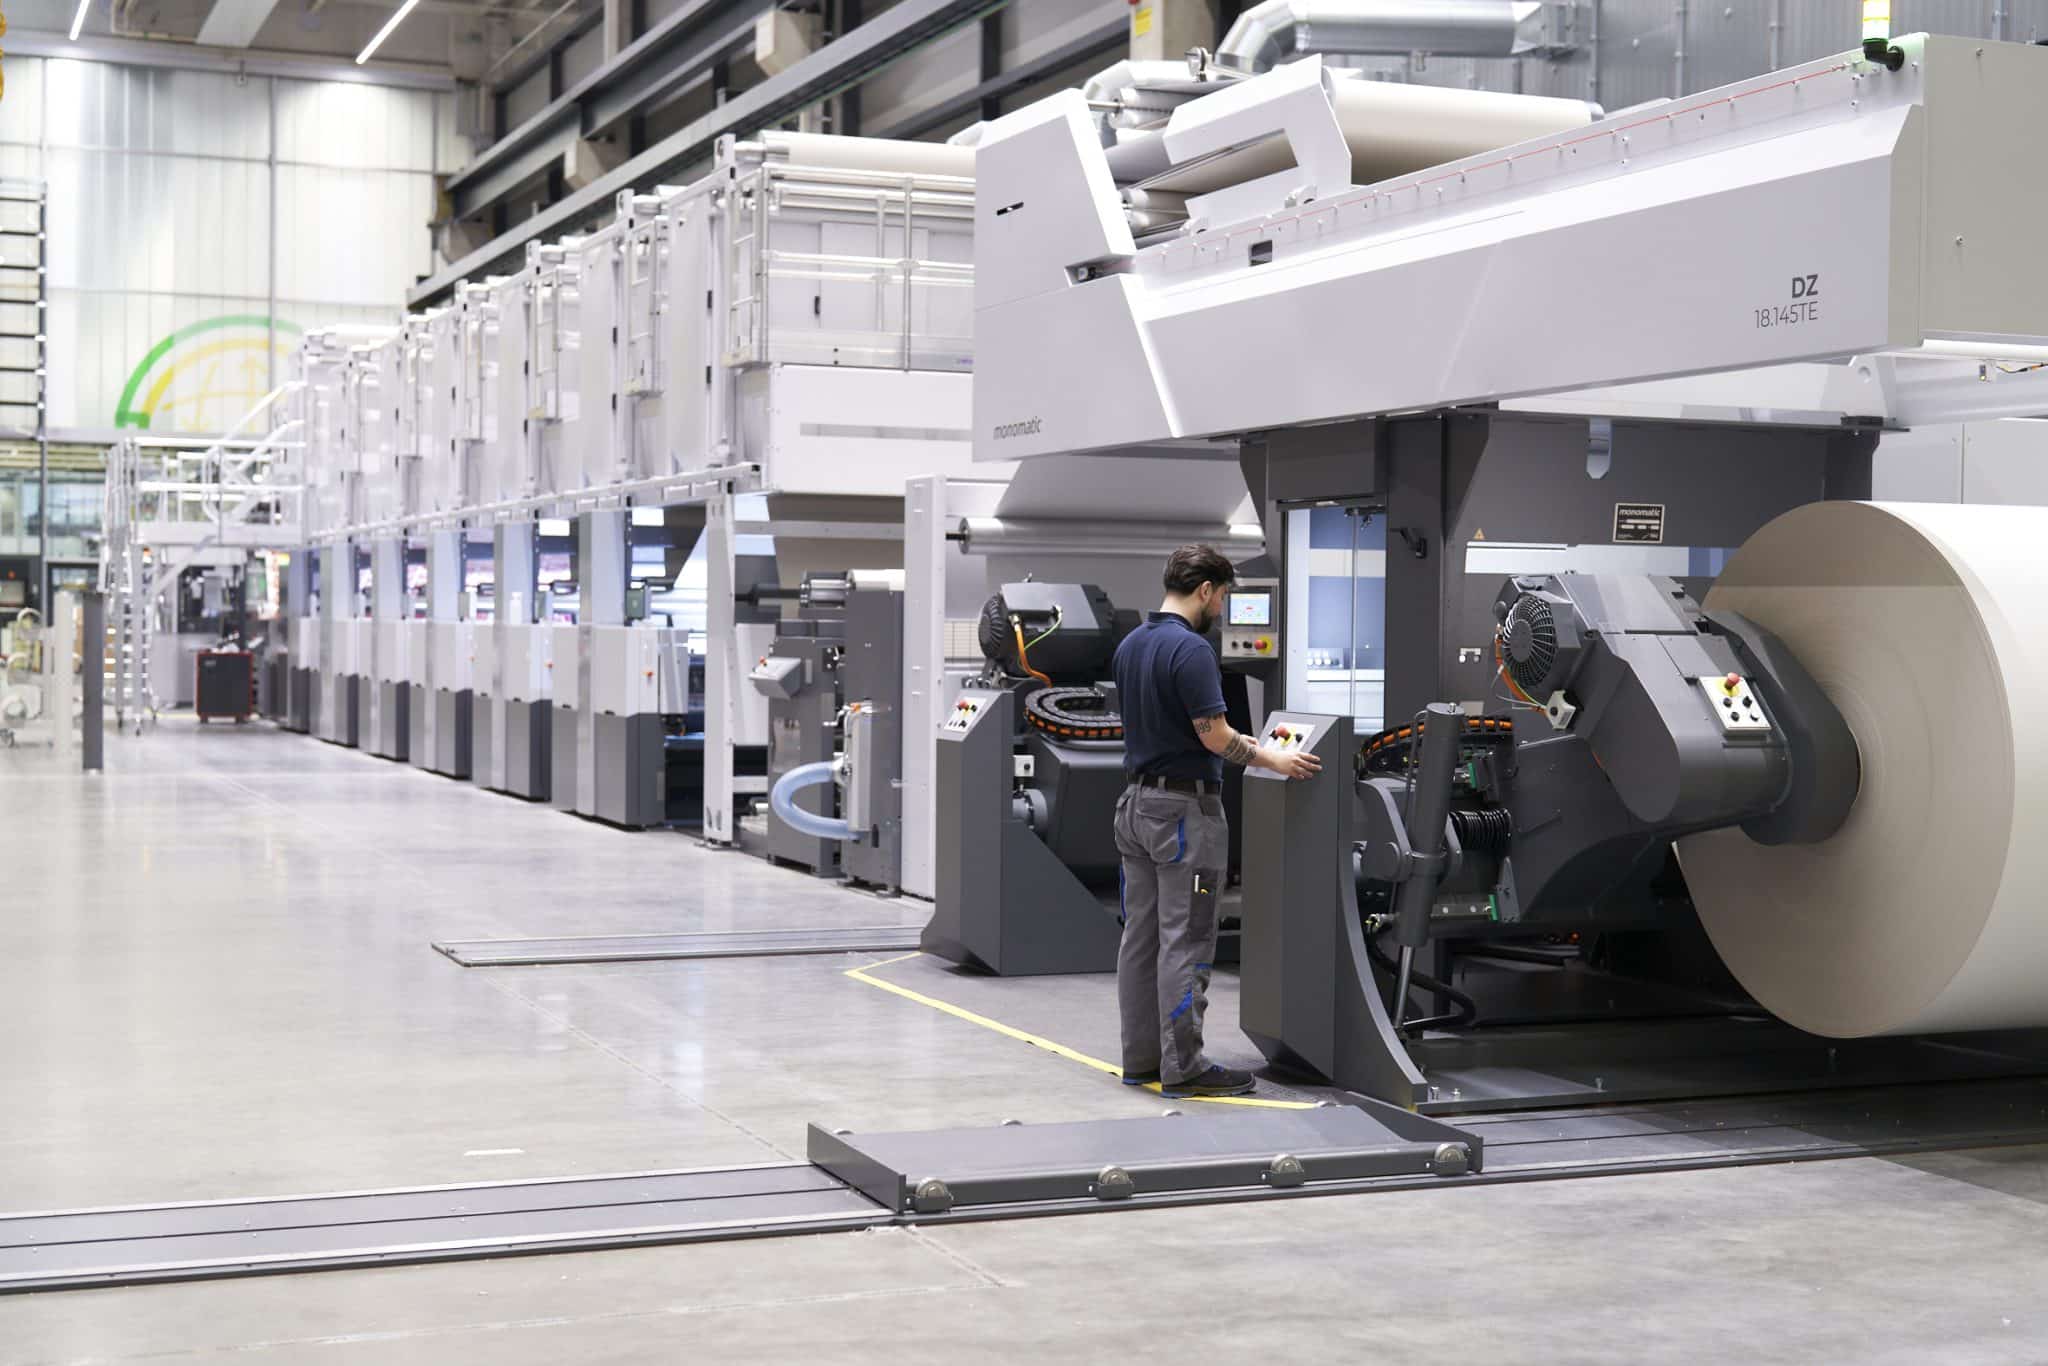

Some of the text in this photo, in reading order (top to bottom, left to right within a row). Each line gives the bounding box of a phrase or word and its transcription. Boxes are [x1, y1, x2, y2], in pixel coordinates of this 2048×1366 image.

[1791, 274, 1818, 299] DZ
[1754, 301, 1819, 328] 18.145TE
[993, 416, 1042, 440] monomatic
[1619, 508, 1661, 516] monomatic
